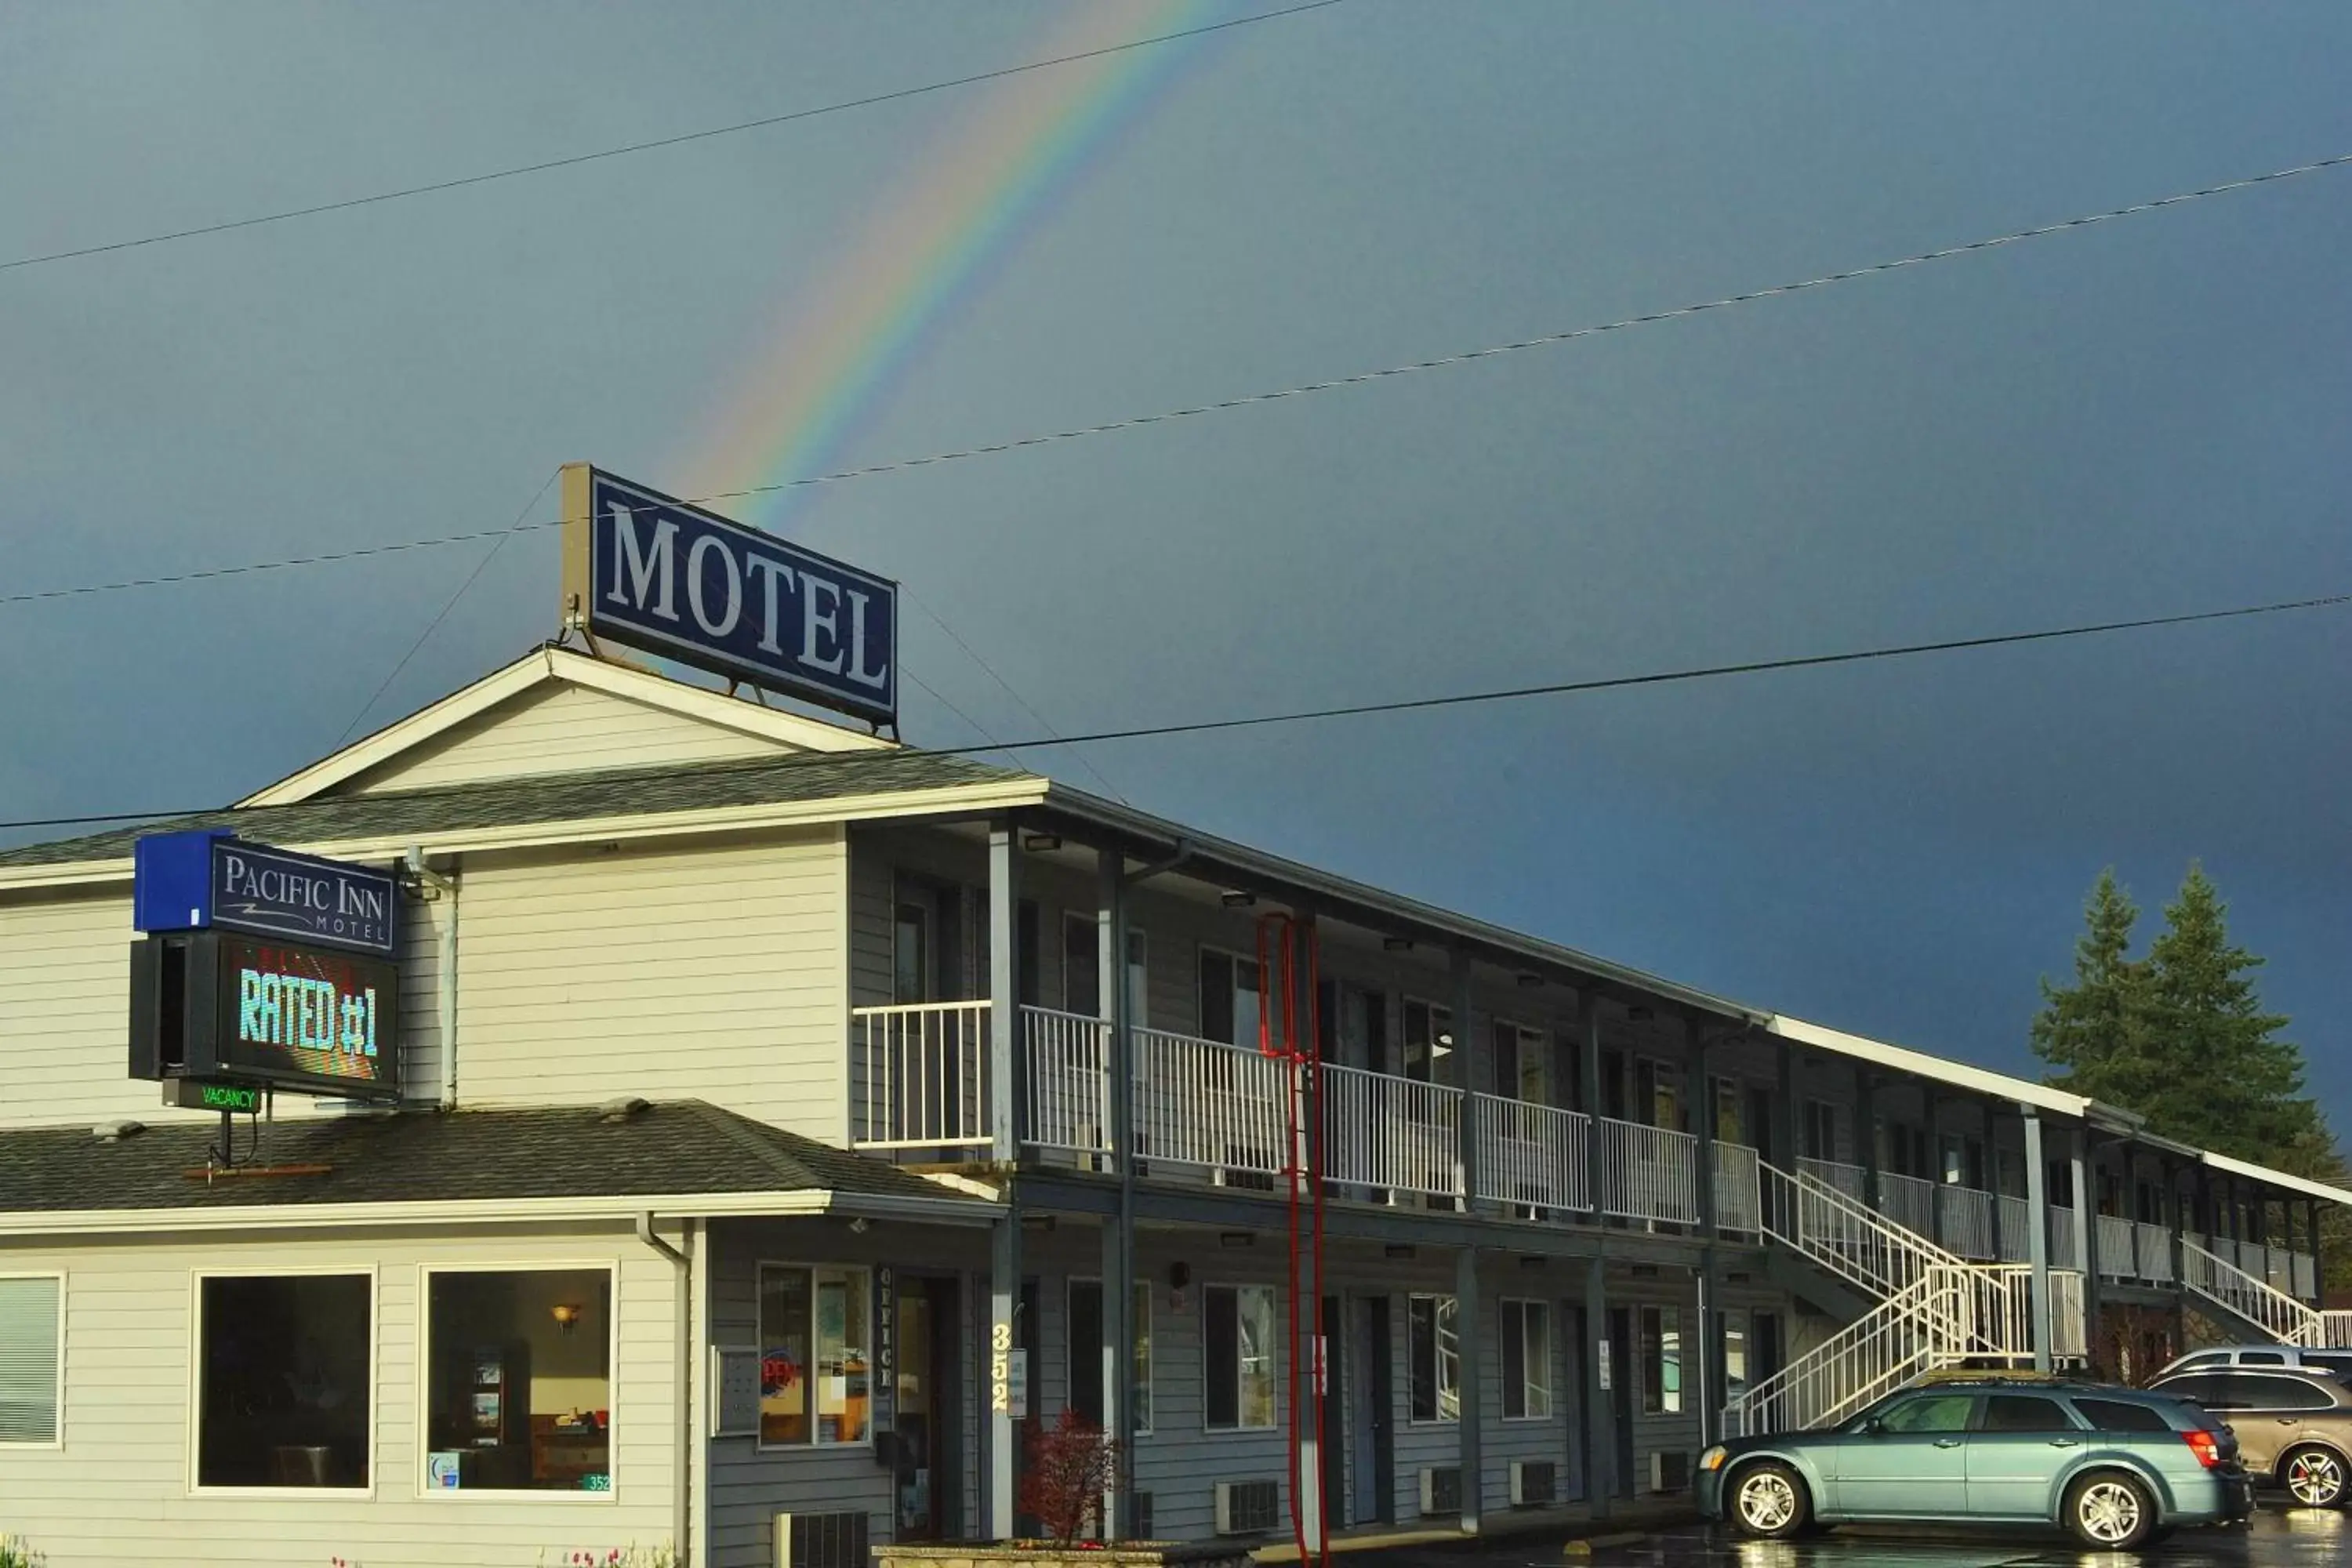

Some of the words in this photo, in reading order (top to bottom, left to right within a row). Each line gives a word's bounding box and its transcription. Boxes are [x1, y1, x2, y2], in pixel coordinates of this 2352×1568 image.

[606, 500, 887, 690] MOTEL
[225, 855, 330, 911] PACIFIC
[337, 877, 384, 921] INN
[316, 915, 384, 941] MOTEL
[240, 968, 336, 1052] RATED
[341, 986, 378, 1057] #1
[202, 1087, 256, 1109] VACANCY
[992, 1323, 1011, 1410] 352
